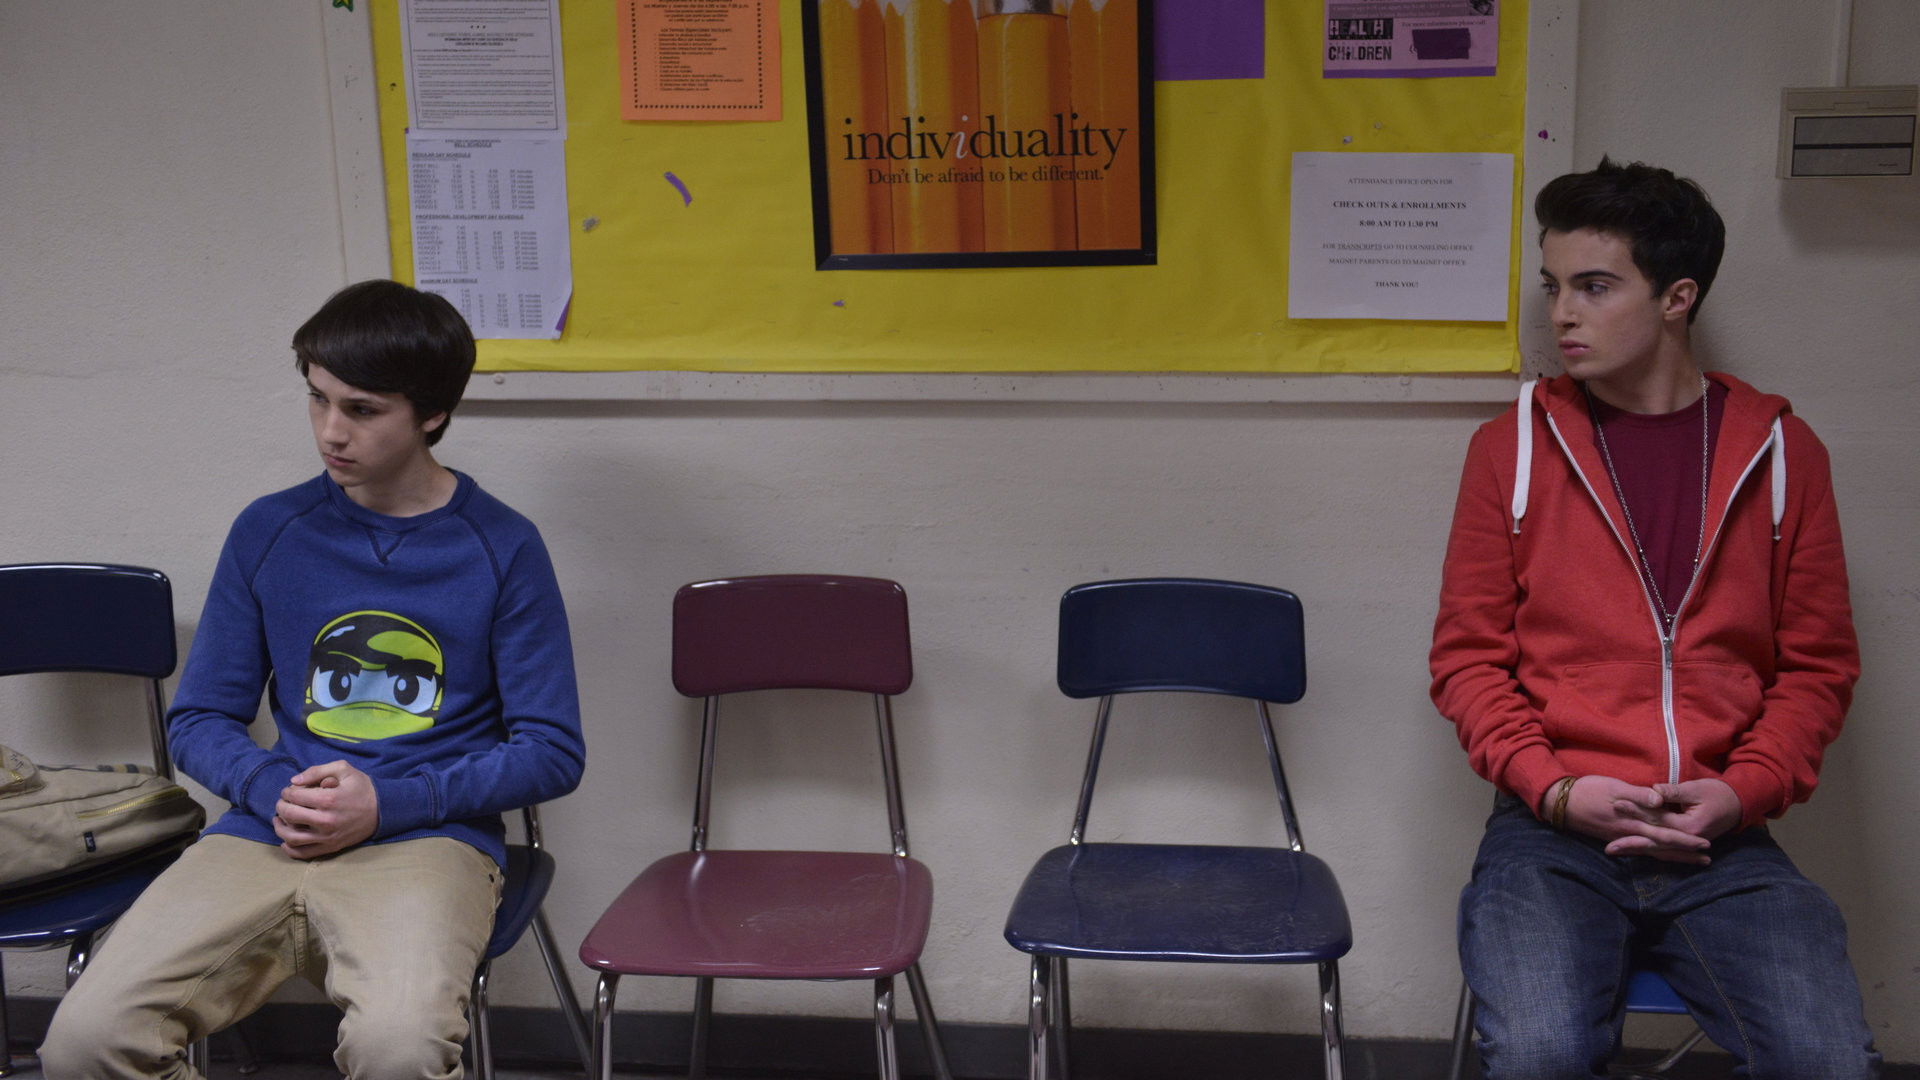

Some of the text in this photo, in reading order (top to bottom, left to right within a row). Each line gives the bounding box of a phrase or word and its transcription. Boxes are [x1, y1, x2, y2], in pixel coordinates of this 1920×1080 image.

[1328, 46, 1392, 60] CHILDREN
[844, 112, 1127, 170] individuality
[868, 165, 1104, 184] Don't be afraid to be different.
